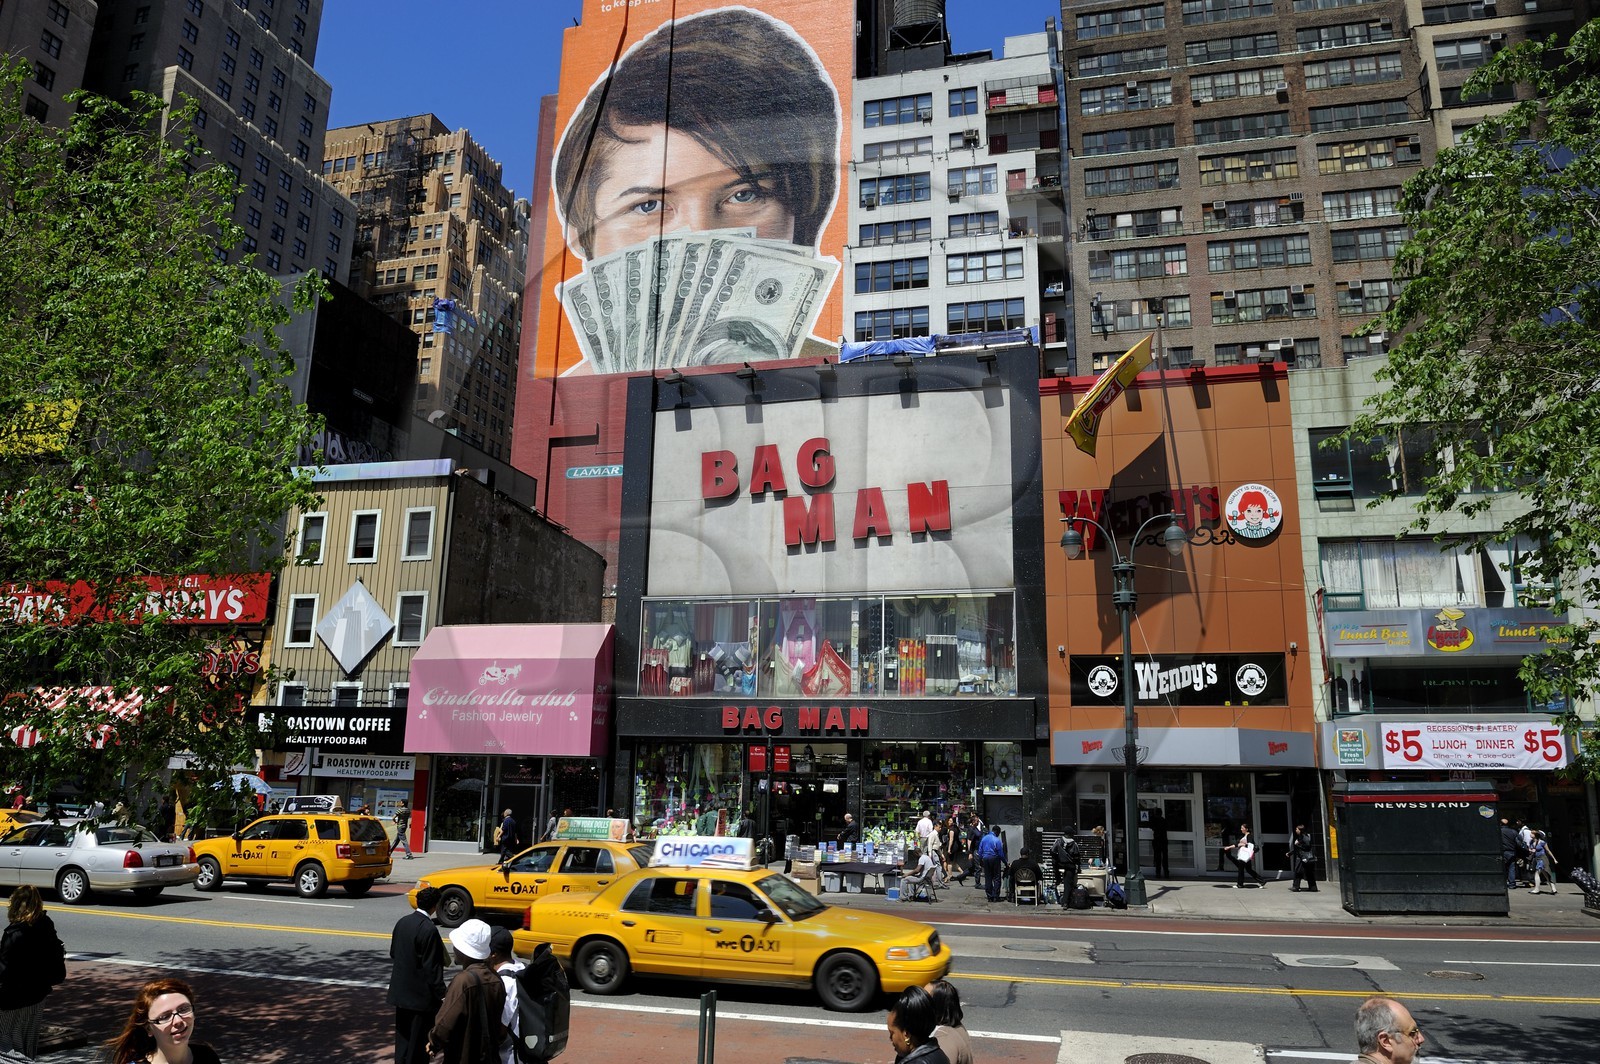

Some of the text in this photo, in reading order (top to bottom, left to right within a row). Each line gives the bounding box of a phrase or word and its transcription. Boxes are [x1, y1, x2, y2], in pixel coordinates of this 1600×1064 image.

[601, 4, 612, 12] to
[573, 467, 620, 477] LAMAR
[701, 437, 835, 500] BAG
[1228, 488, 1243, 505] QUALITY
[1263, 488, 1278, 502] RECIPE
[783, 480, 952, 547] MAN
[1340, 628, 1408, 640] Lunch Box
[1499, 626, 1536, 637] Lunch
[422, 687, 583, 707] Cinderella club
[451, 709, 543, 725] Fashion Jewelry
[721, 705, 870, 731] BAG MAN
[284, 717, 391, 732] OASTOWN COFFEE
[1426, 725, 1474, 733] RECESSION'S
[285, 735, 368, 745] HEALTHY FOOD BAR
[1385, 729, 1423, 762] $5
[1432, 739, 1515, 750] LUNCH DINNER
[1523, 729, 1563, 762] $5
[327, 758, 410, 770] ROASTOWN COFFEE
[1452, 771, 1473, 780] ATM
[243, 850, 263, 860] TAXI
[661, 843, 735, 857] CHICAGO
[511, 882, 538, 895] TAXI
[715, 934, 779, 952] NYC TAXI
